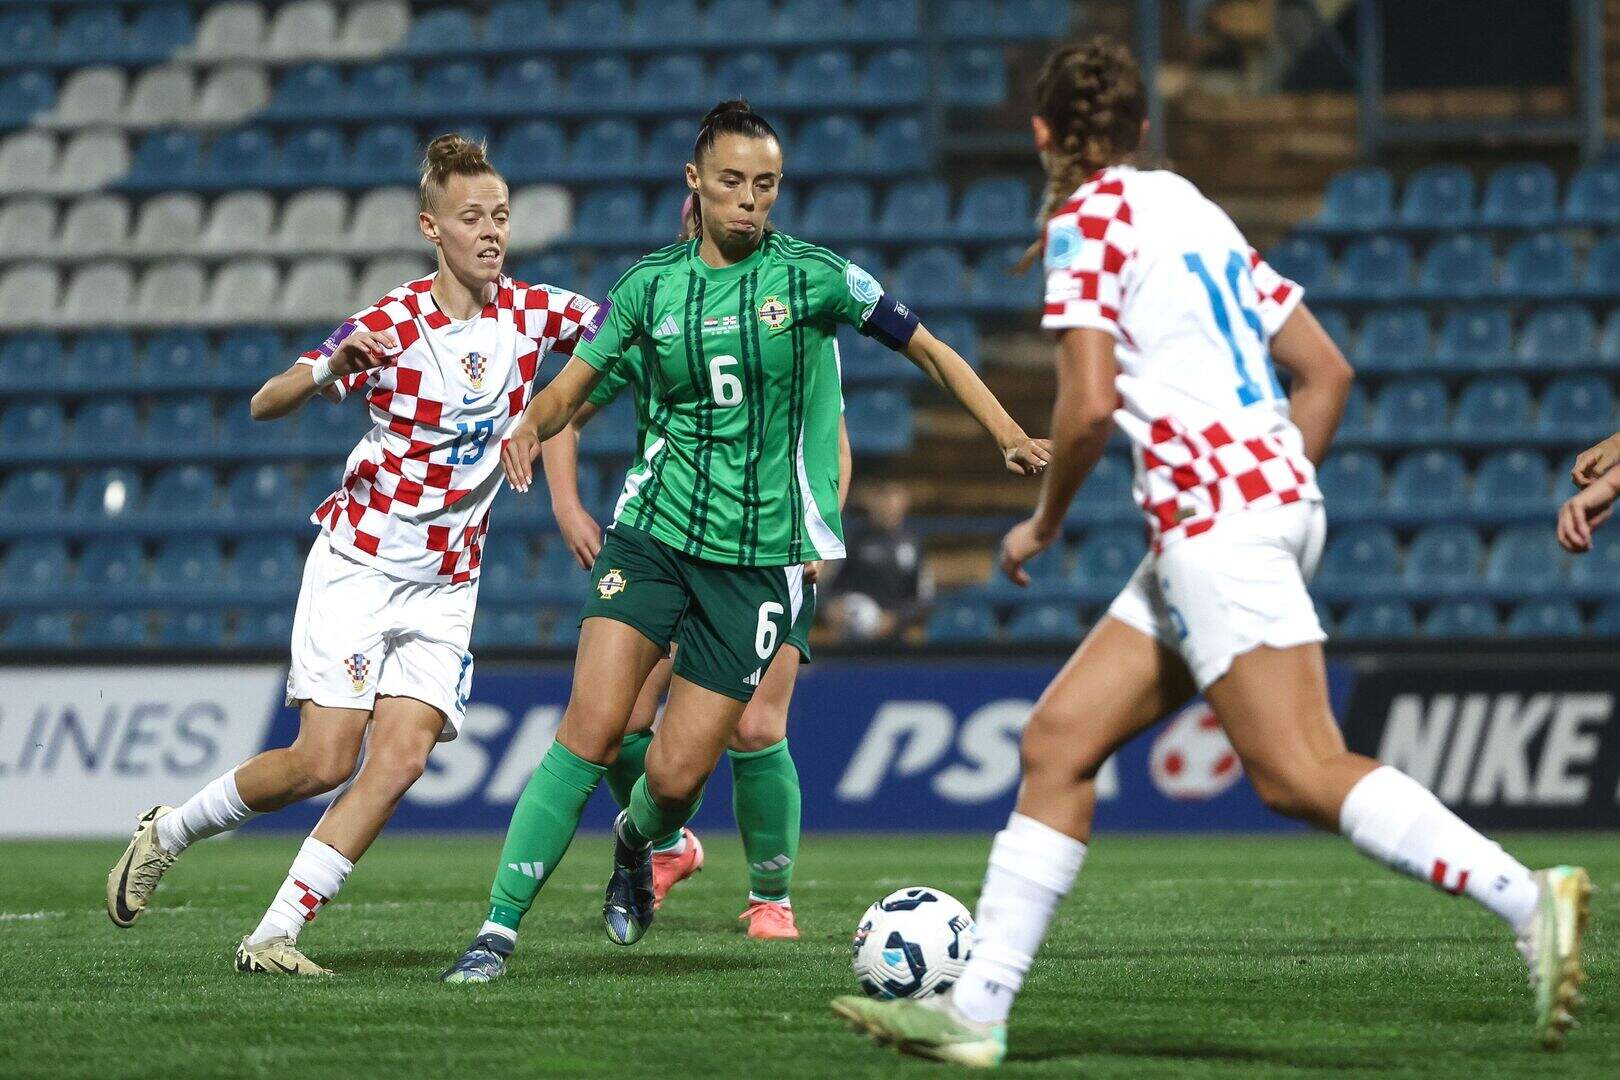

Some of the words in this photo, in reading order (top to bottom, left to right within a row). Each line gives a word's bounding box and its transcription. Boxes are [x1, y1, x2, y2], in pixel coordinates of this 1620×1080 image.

[709, 354, 744, 408] 6
[446, 419, 494, 465] 19
[755, 601, 784, 660] 6
[836, 699, 1119, 803] PS
[1379, 692, 1615, 806] NIKE
